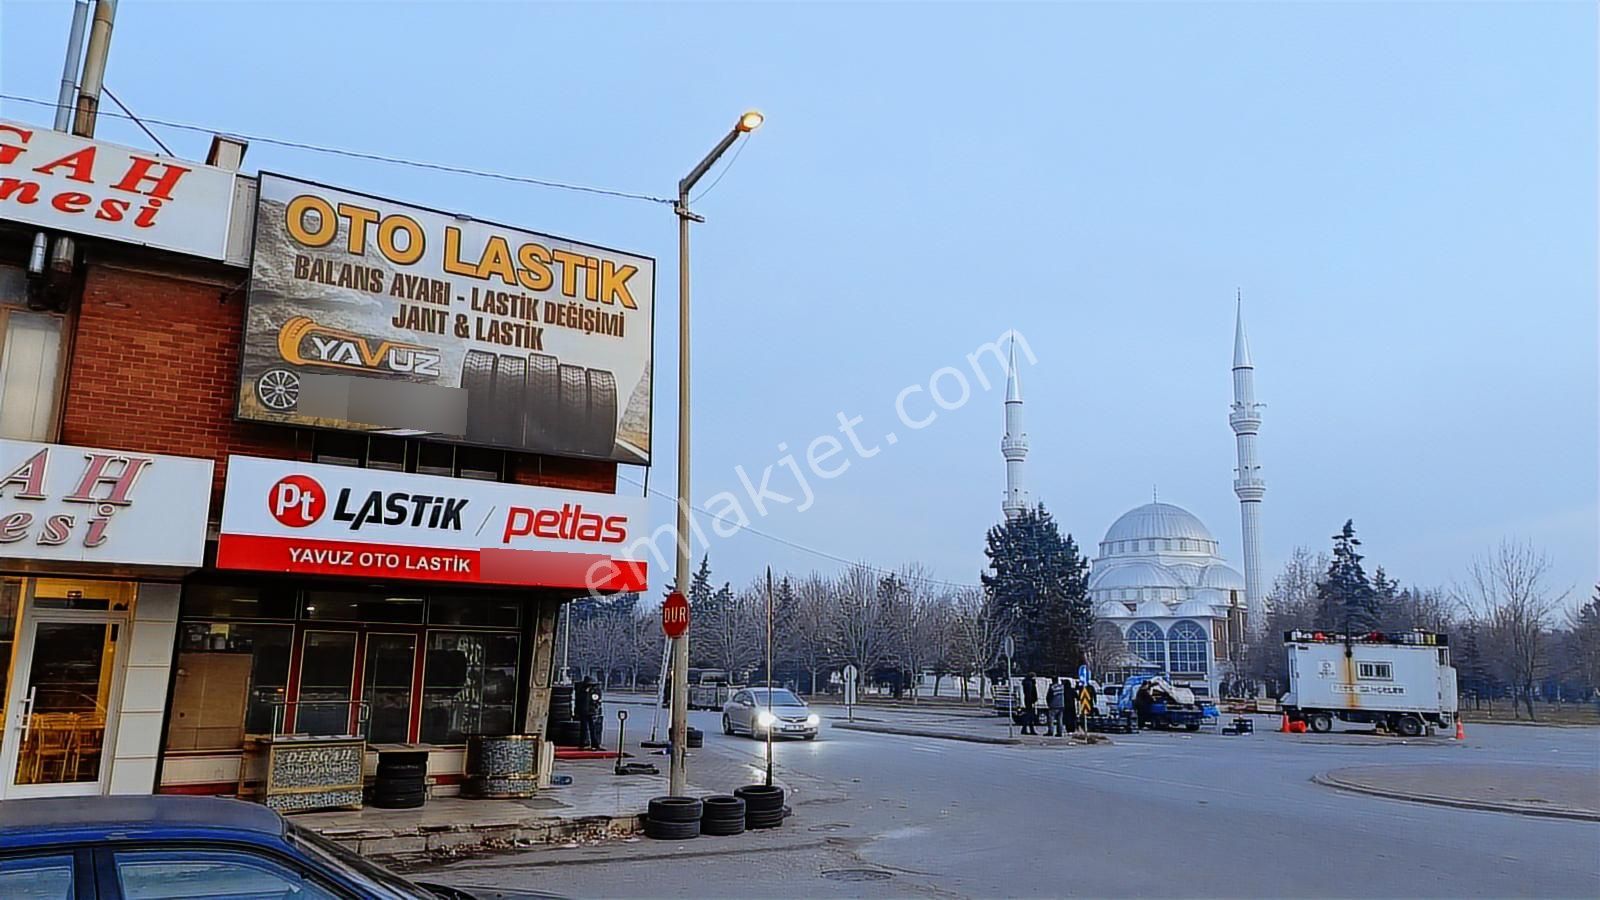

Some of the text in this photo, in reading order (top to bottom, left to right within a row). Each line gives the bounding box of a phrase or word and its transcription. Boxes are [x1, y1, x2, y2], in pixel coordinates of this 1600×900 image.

[285, 194, 426, 265] OTO
[294, 255, 384, 294] BALANS
[390, 273, 450, 306] AYARI
[392, 304, 449, 335] JANT
[453, 313, 471, 339] &
[312, 336, 441, 377] YAVUZ
[502, 503, 628, 543] petlas
[289, 547, 353, 566] YAVUZ
[359, 552, 399, 568] OTO
[664, 606, 686, 623] DUR
